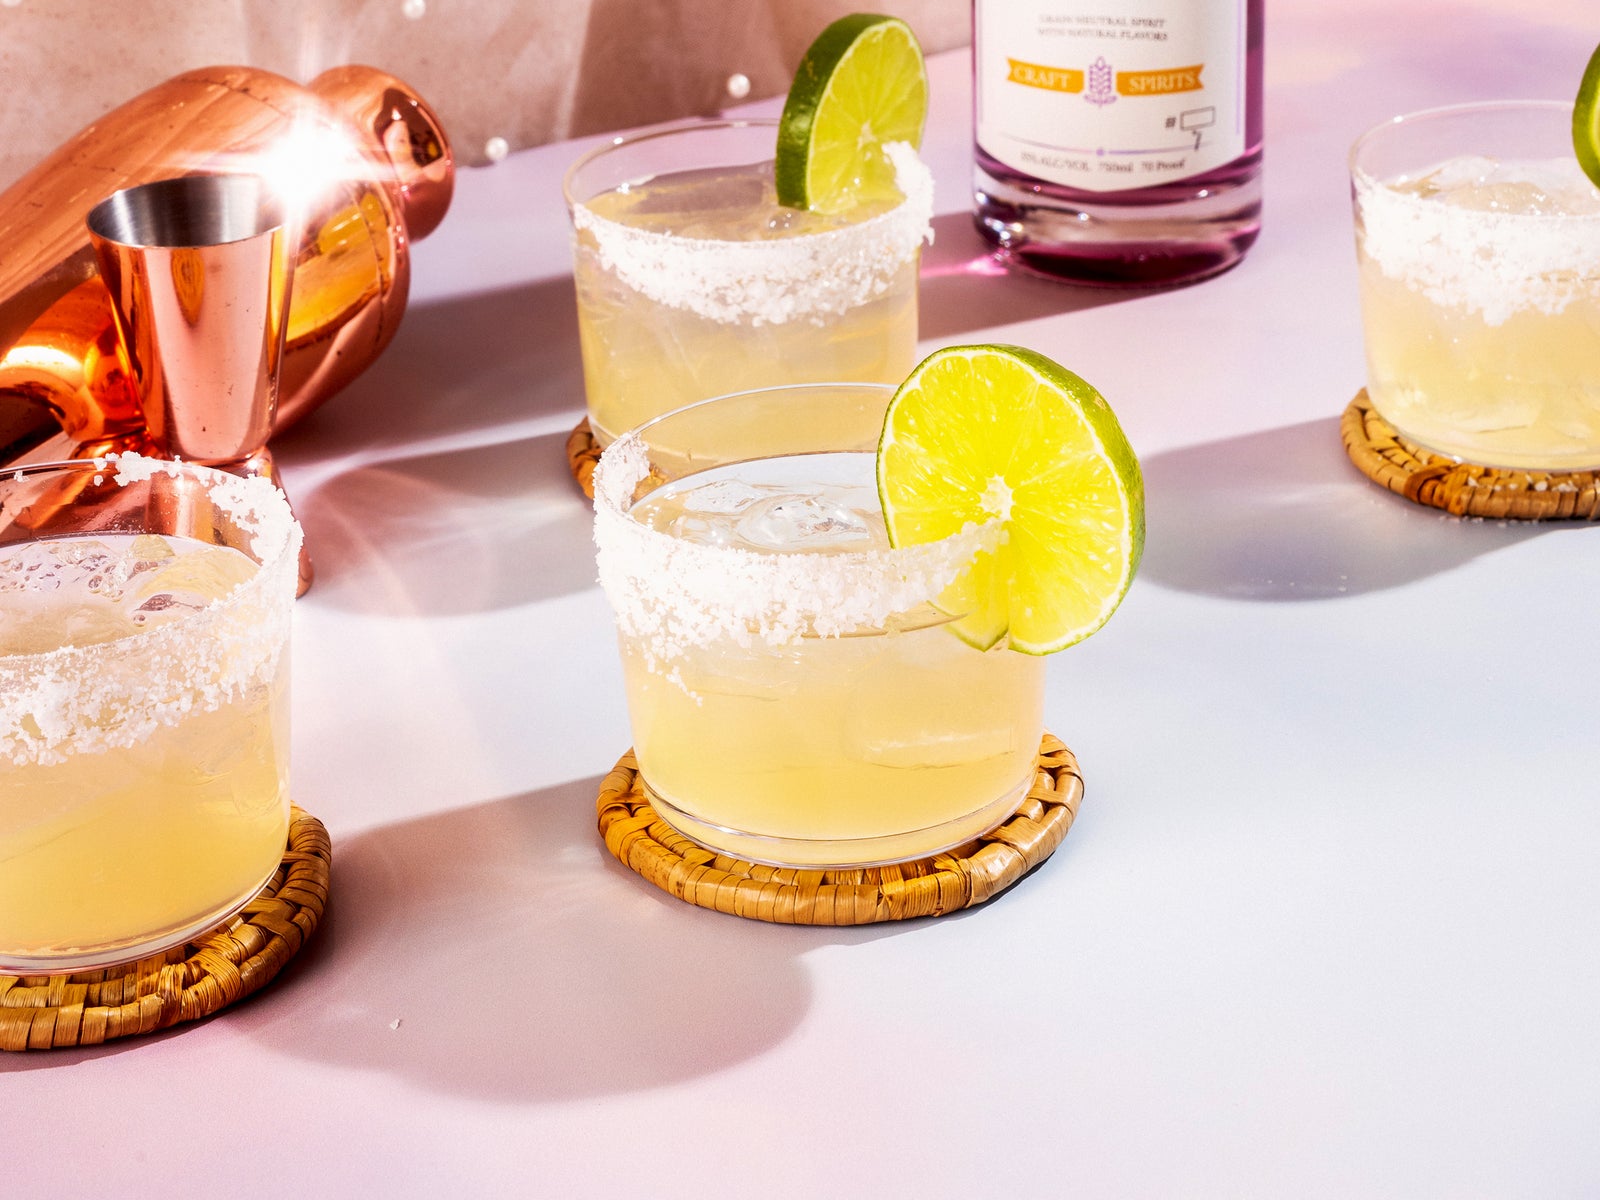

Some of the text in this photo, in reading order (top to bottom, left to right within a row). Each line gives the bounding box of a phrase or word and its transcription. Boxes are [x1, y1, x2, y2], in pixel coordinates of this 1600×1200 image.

[1012, 64, 1196, 93] CRAFT SPIRITS
[1155, 157, 1187, 172] Proof
